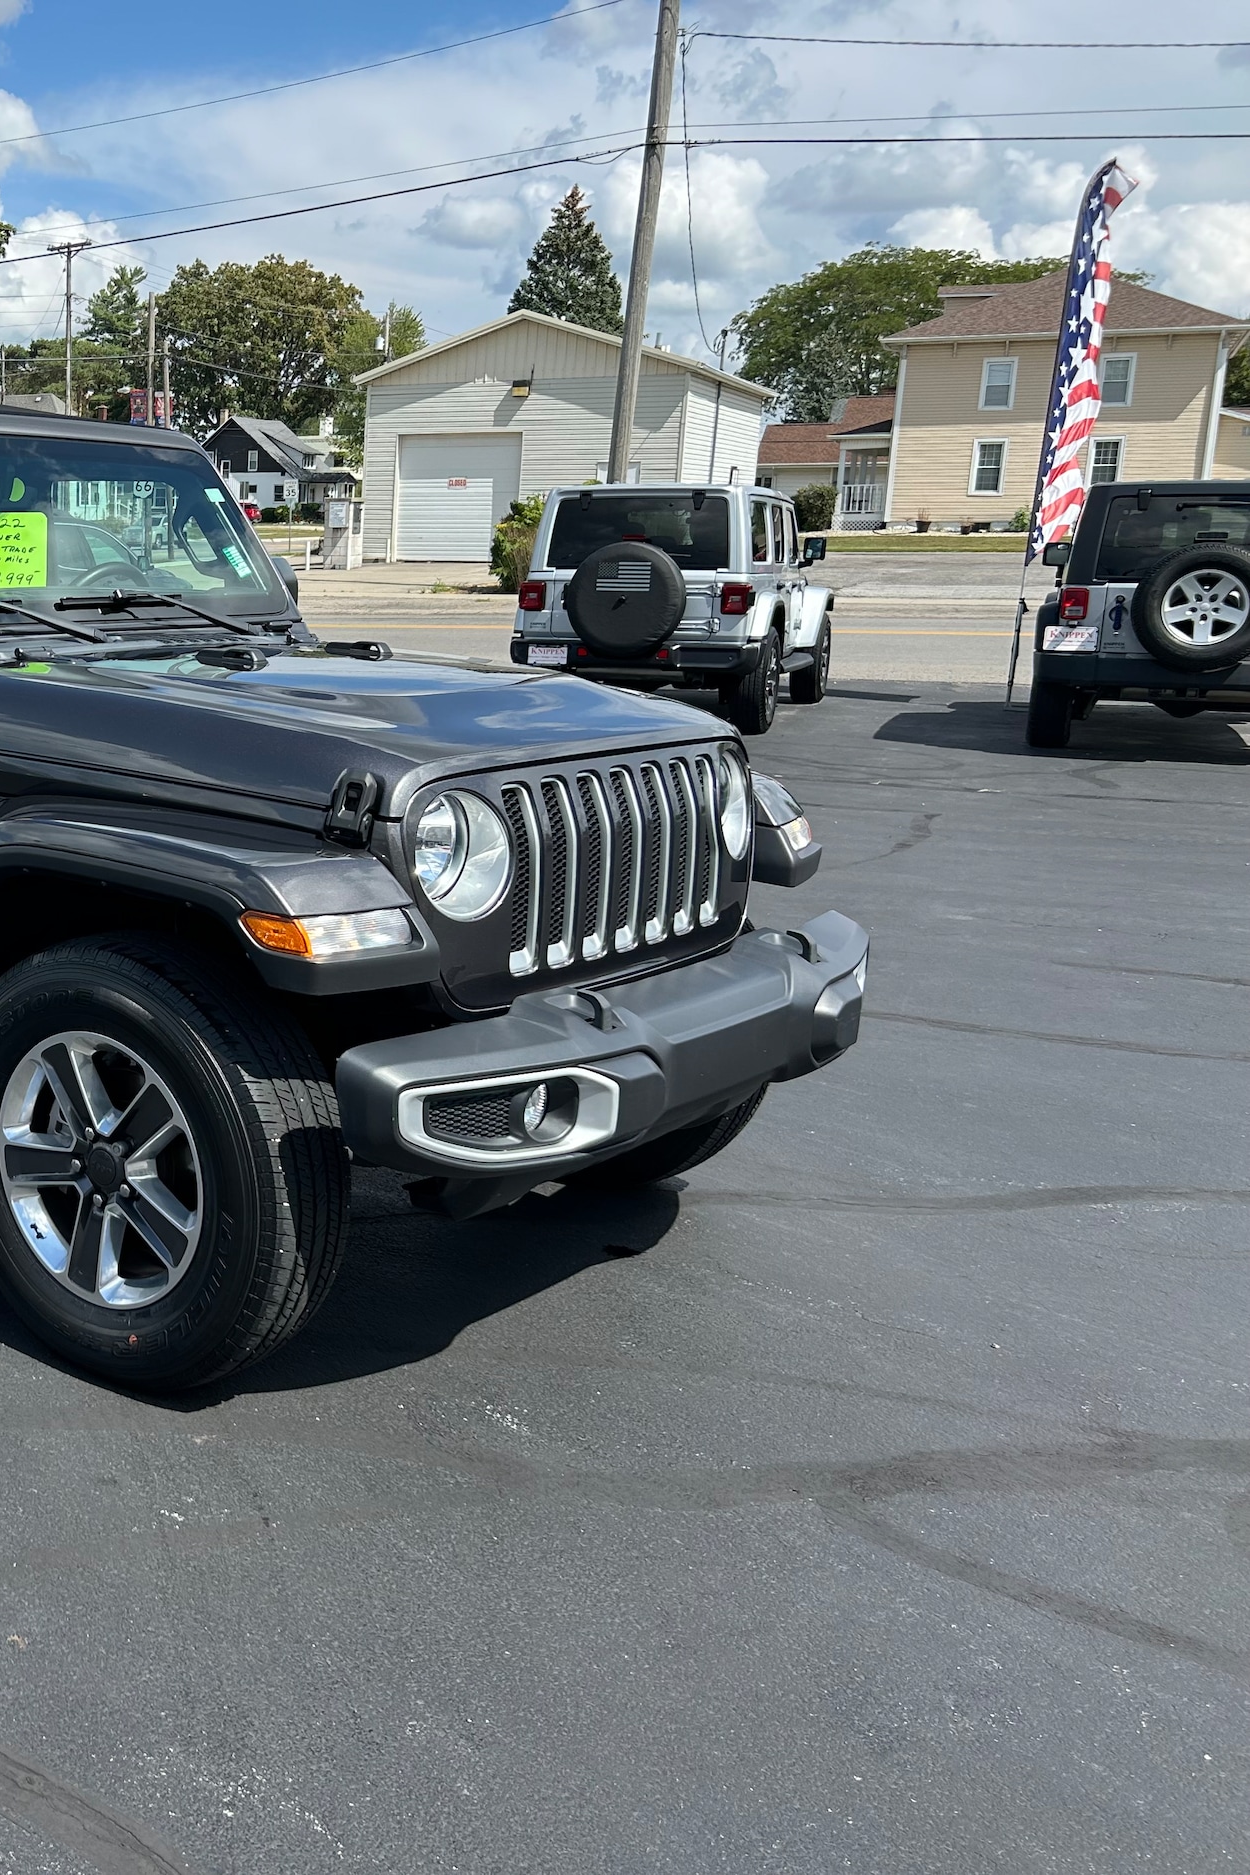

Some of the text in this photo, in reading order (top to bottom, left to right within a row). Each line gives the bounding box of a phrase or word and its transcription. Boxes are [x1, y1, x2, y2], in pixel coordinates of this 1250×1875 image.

[135, 481, 152, 492] 66
[285, 489, 297, 497] 35
[1, 545, 37, 554] TRADE
[1049, 630, 1093, 639] KNIPPEN
[530, 647, 566, 655] KNIPPEN
